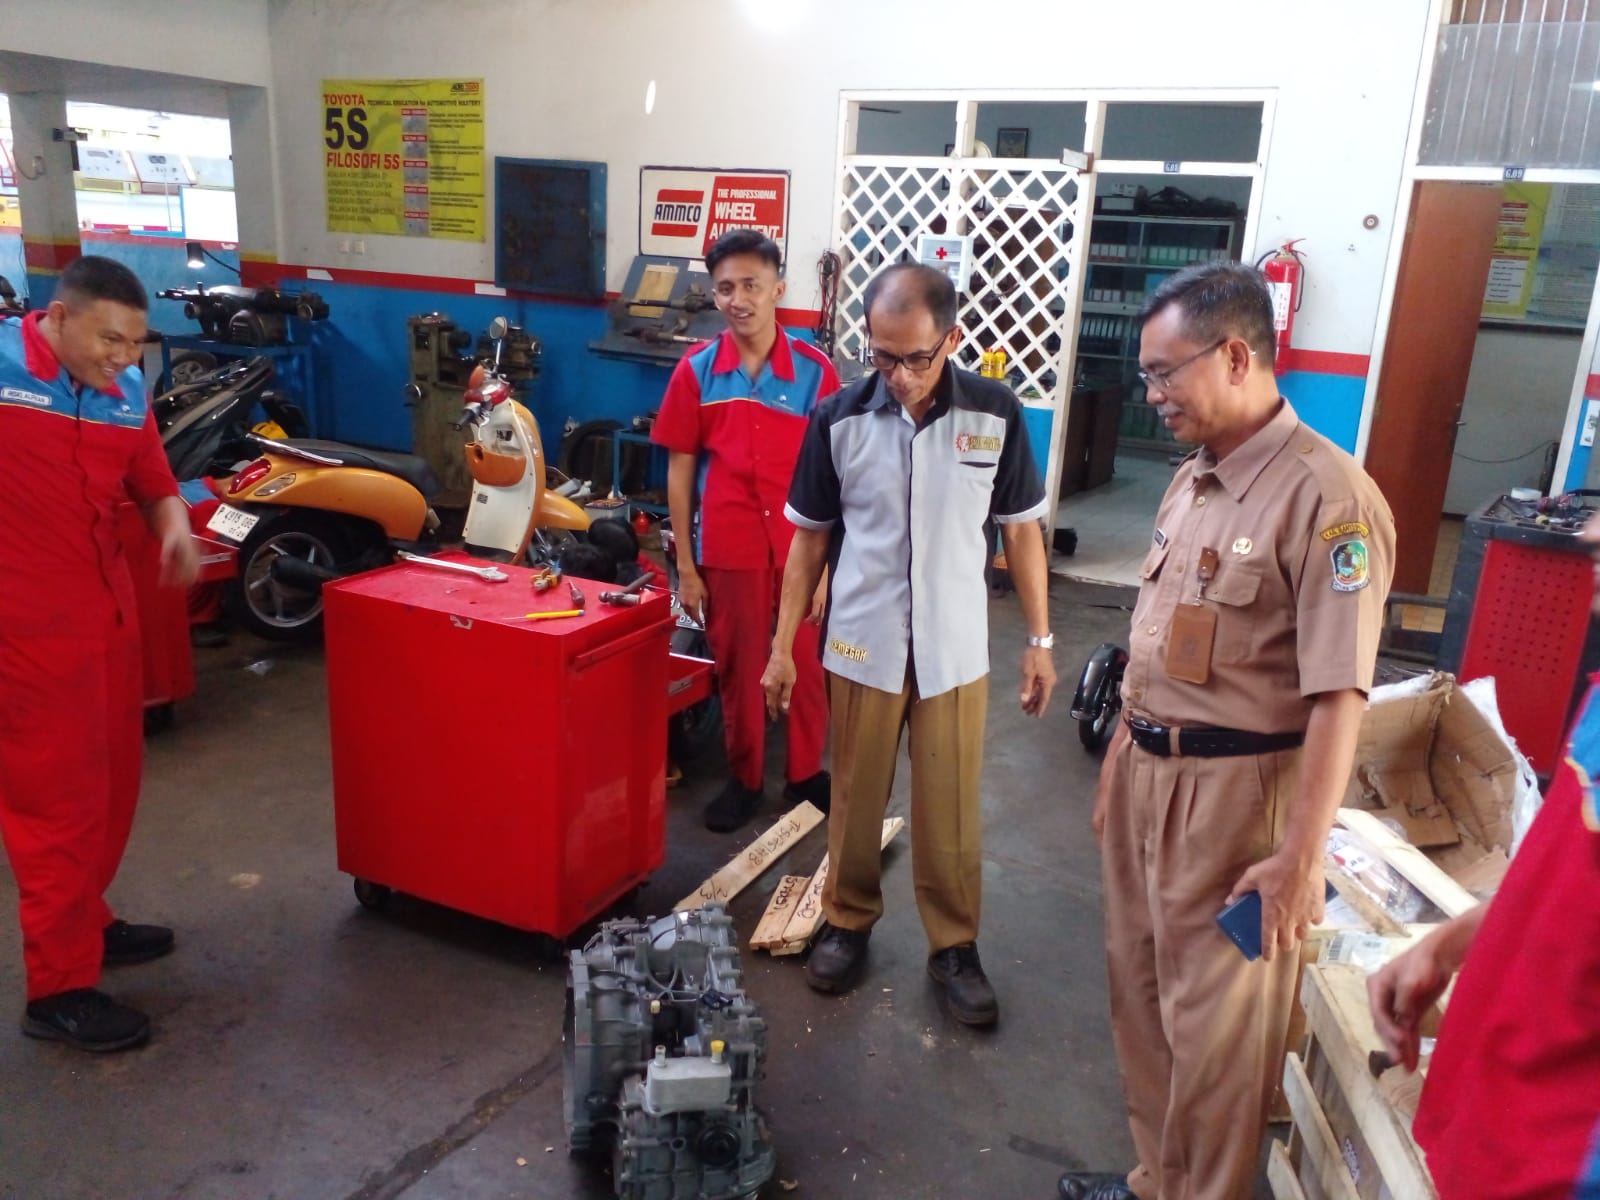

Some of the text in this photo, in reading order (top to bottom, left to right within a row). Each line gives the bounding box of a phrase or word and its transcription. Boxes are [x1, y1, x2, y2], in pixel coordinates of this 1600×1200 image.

[323, 94, 366, 106] TOYOTA
[325, 108, 369, 150] 5S
[326, 152, 400, 170] FILOSOFI 5S
[718, 188, 777, 200] THE PROFESSIONAL
[654, 203, 702, 222] AMMCO
[715, 202, 757, 221] WHEEL
